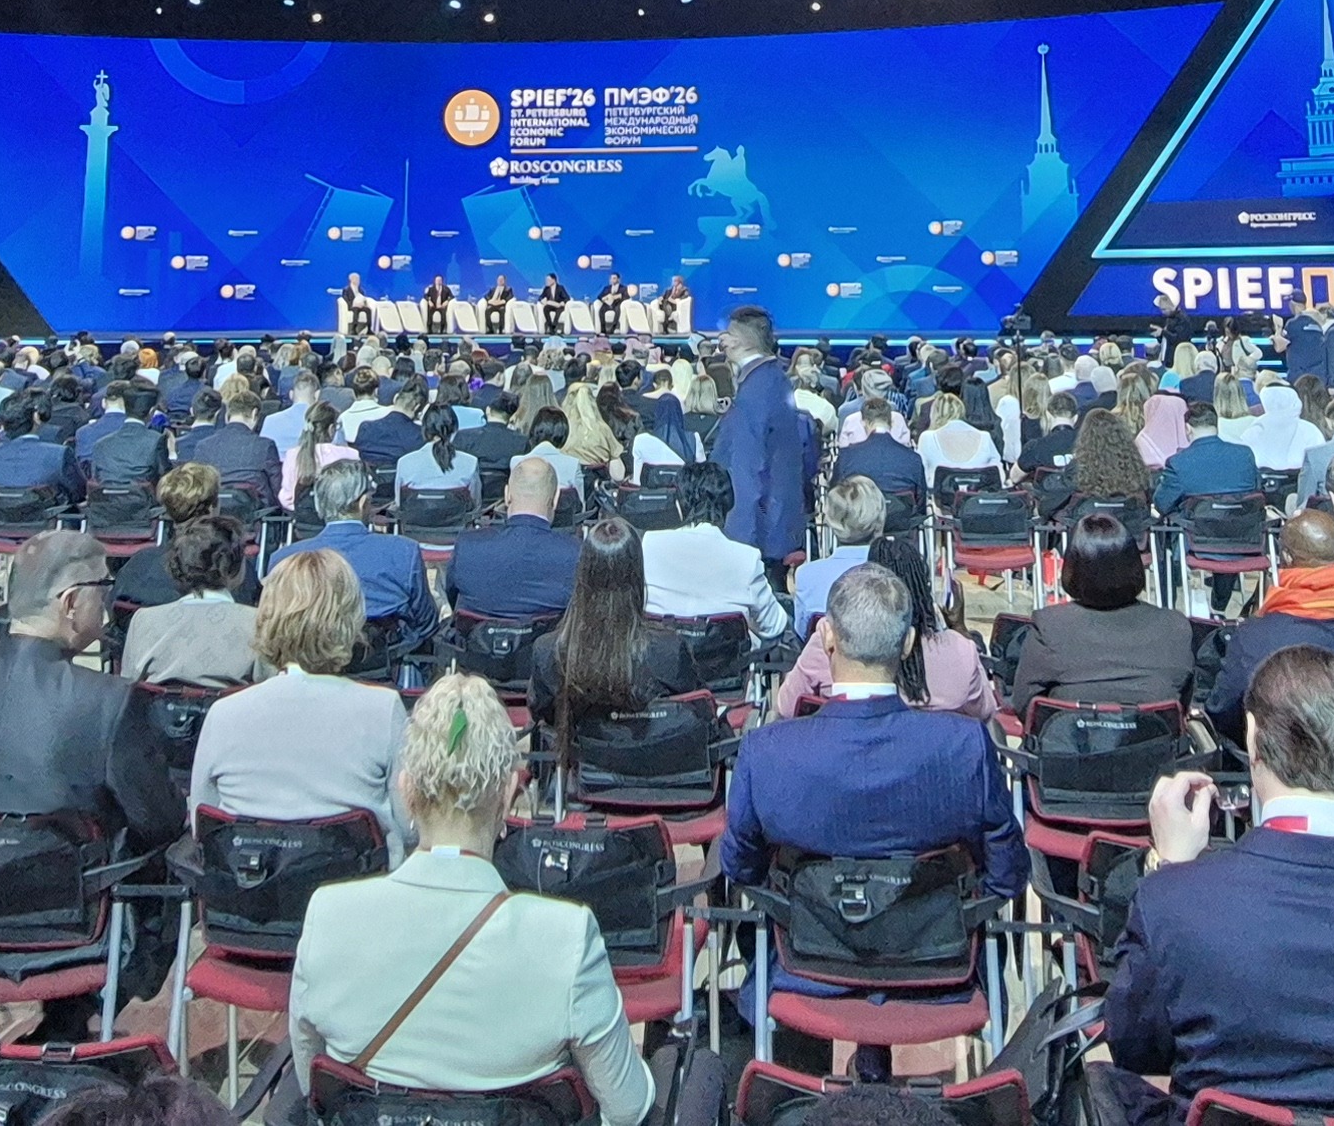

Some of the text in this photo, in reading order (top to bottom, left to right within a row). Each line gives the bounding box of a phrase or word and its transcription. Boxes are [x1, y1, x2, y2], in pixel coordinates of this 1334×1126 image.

[510, 87, 596, 107] SPIEF'26
[604, 86, 698, 107] ПМЭФ'26
[510, 108, 587, 118] ST. PETERSBURG
[604, 105, 685, 117] ПЕТЕРБУРГСКИЙ
[510, 118, 590, 127] INTERNATIONAL
[604, 114, 698, 126] МЕЖДУНАРОДНЫЙ
[510, 127, 564, 137] ECONOMIC
[604, 124, 696, 136] ЭКОНОМИЧЕСКИЙ
[510, 137, 546, 146] FORUM
[604, 135, 641, 146] ФОРУМ
[510, 159, 623, 173] ROSCONGRESS
[1152, 266, 1295, 310] SPIEF
